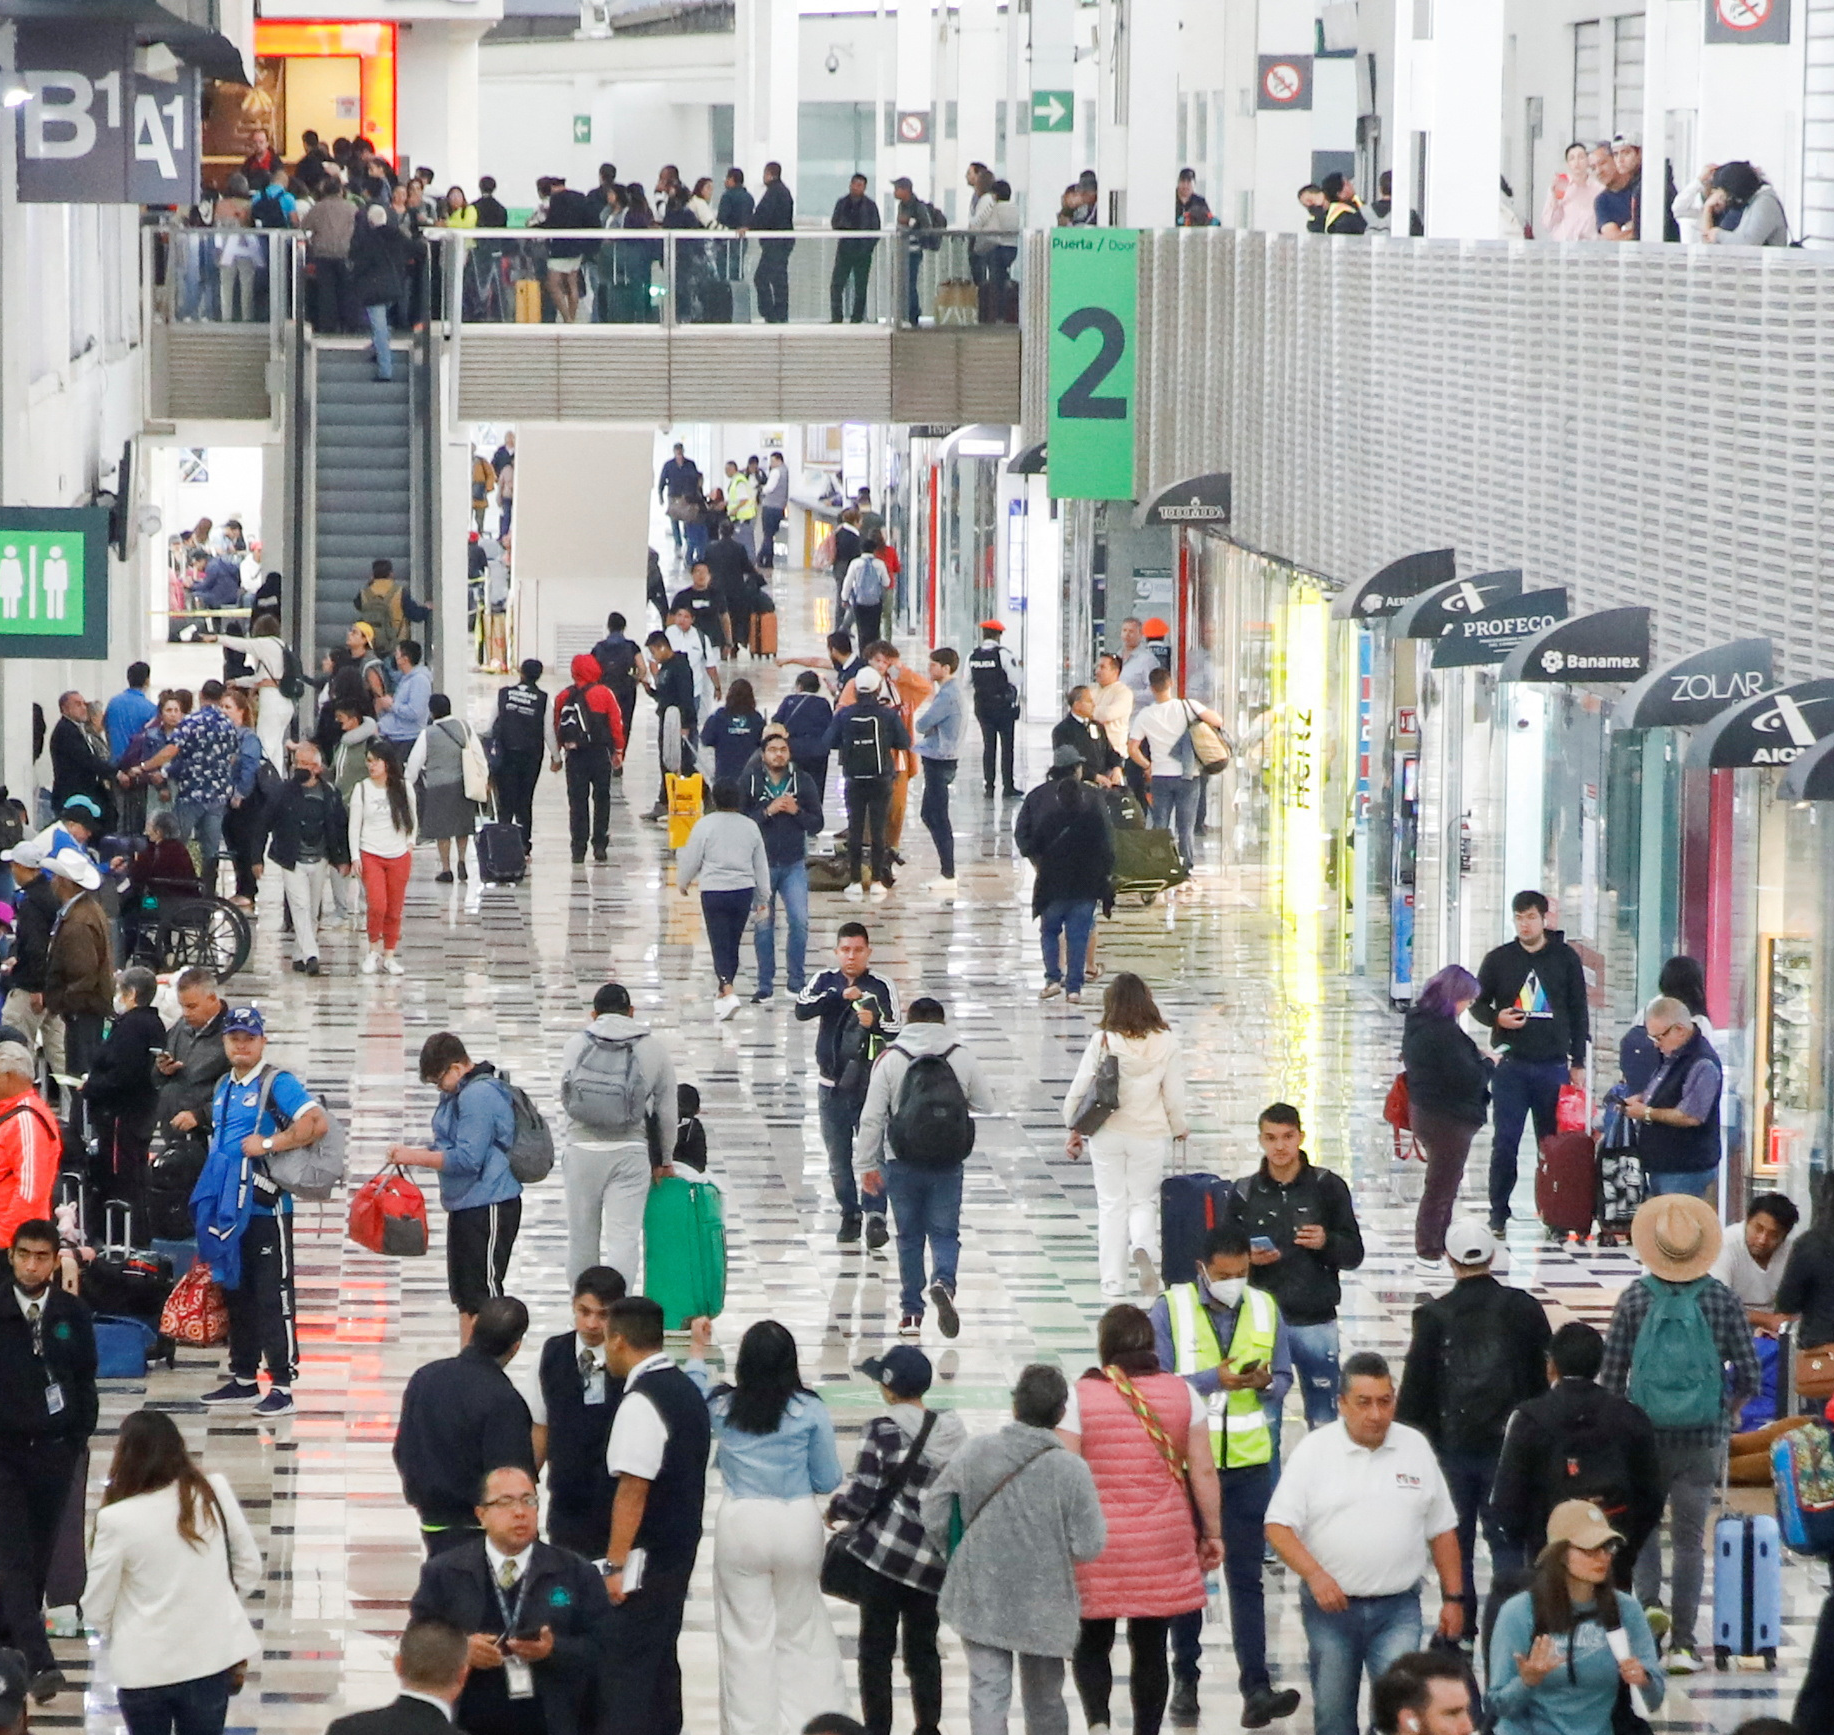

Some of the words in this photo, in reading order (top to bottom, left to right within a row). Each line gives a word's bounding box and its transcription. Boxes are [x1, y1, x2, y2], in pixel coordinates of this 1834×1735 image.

[1052, 237, 1093, 251] Puerta
[1097, 237, 1105, 252] /
[1108, 239, 1136, 251] Door
[1057, 306, 1127, 419] 2
[1463, 615, 1555, 638] PROFECO
[1567, 654, 1640, 669] Banamex
[1670, 671, 1764, 702] ZOLAR
